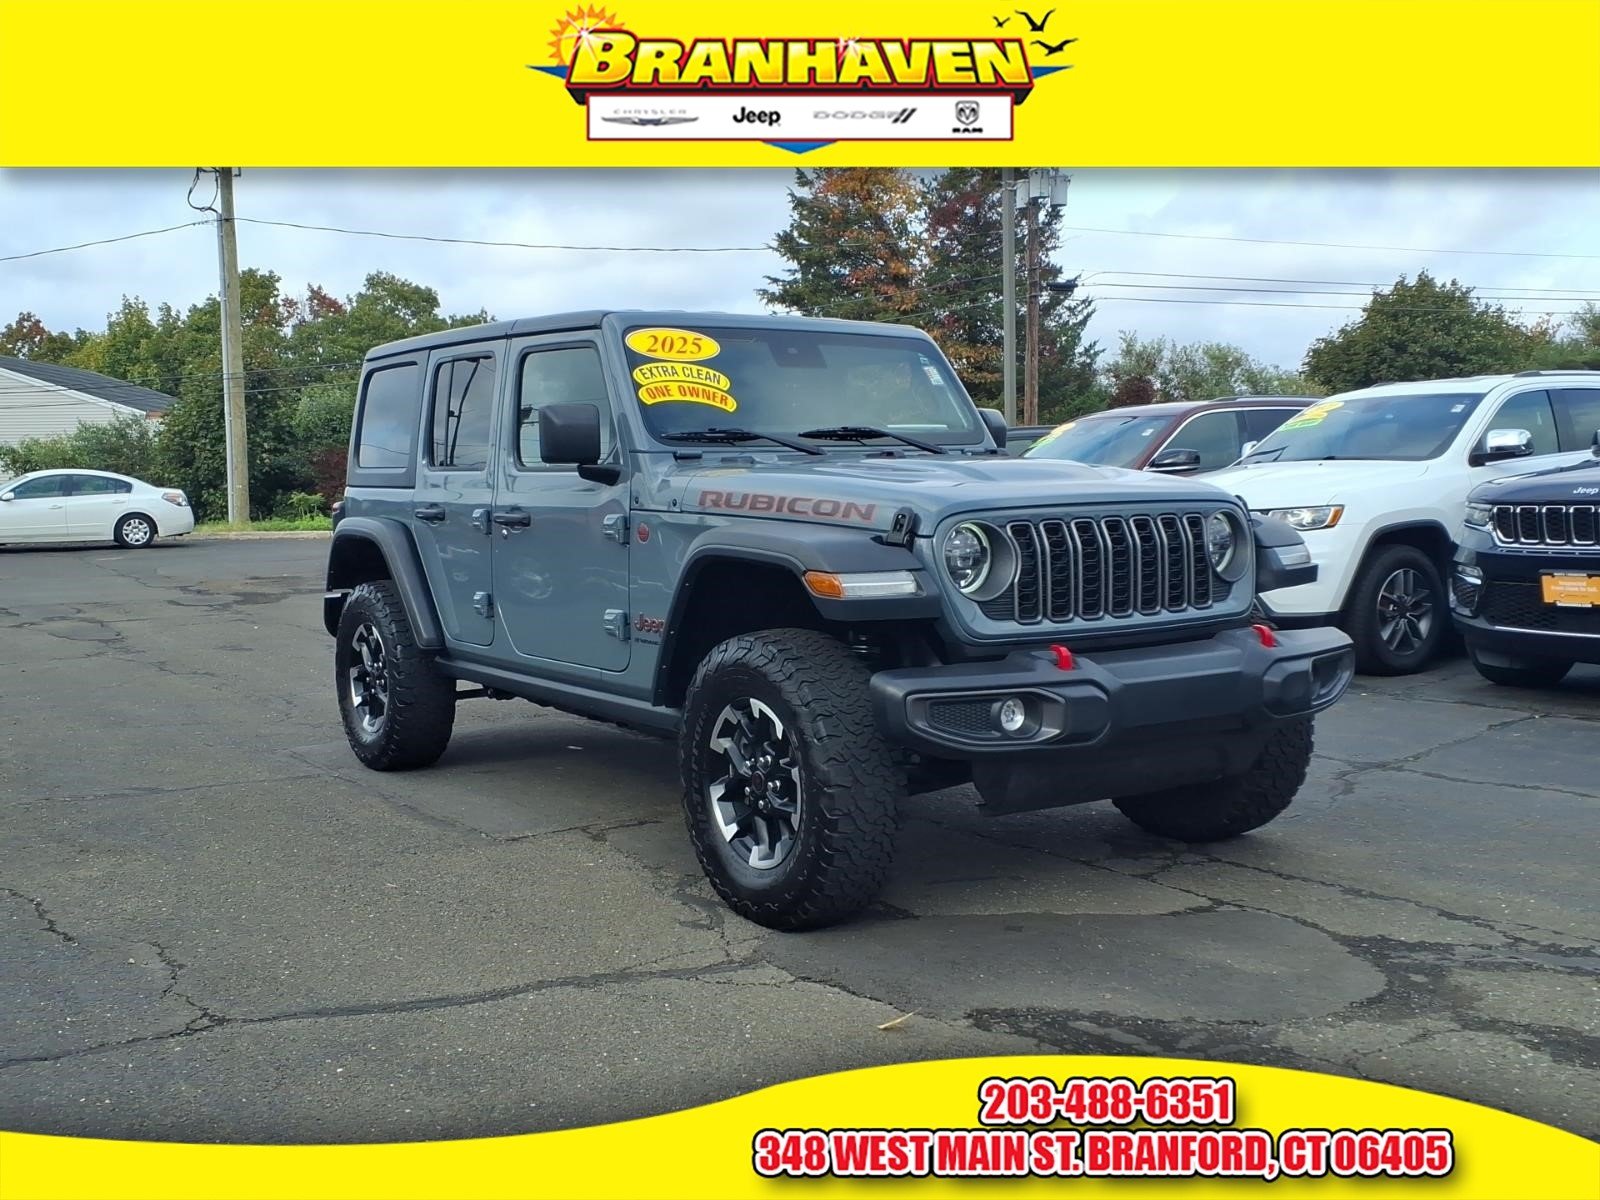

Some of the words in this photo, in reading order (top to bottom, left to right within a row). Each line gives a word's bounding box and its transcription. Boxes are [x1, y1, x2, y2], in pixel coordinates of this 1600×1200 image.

[645, 334, 704, 355] 2025
[638, 365, 680, 381] EXTRA
[681, 366, 721, 386] CLEAN
[645, 384, 674, 400] ONE
[676, 384, 729, 407] OWNER
[1572, 486, 1599, 496] Jeep
[699, 489, 877, 522] RUBICON
